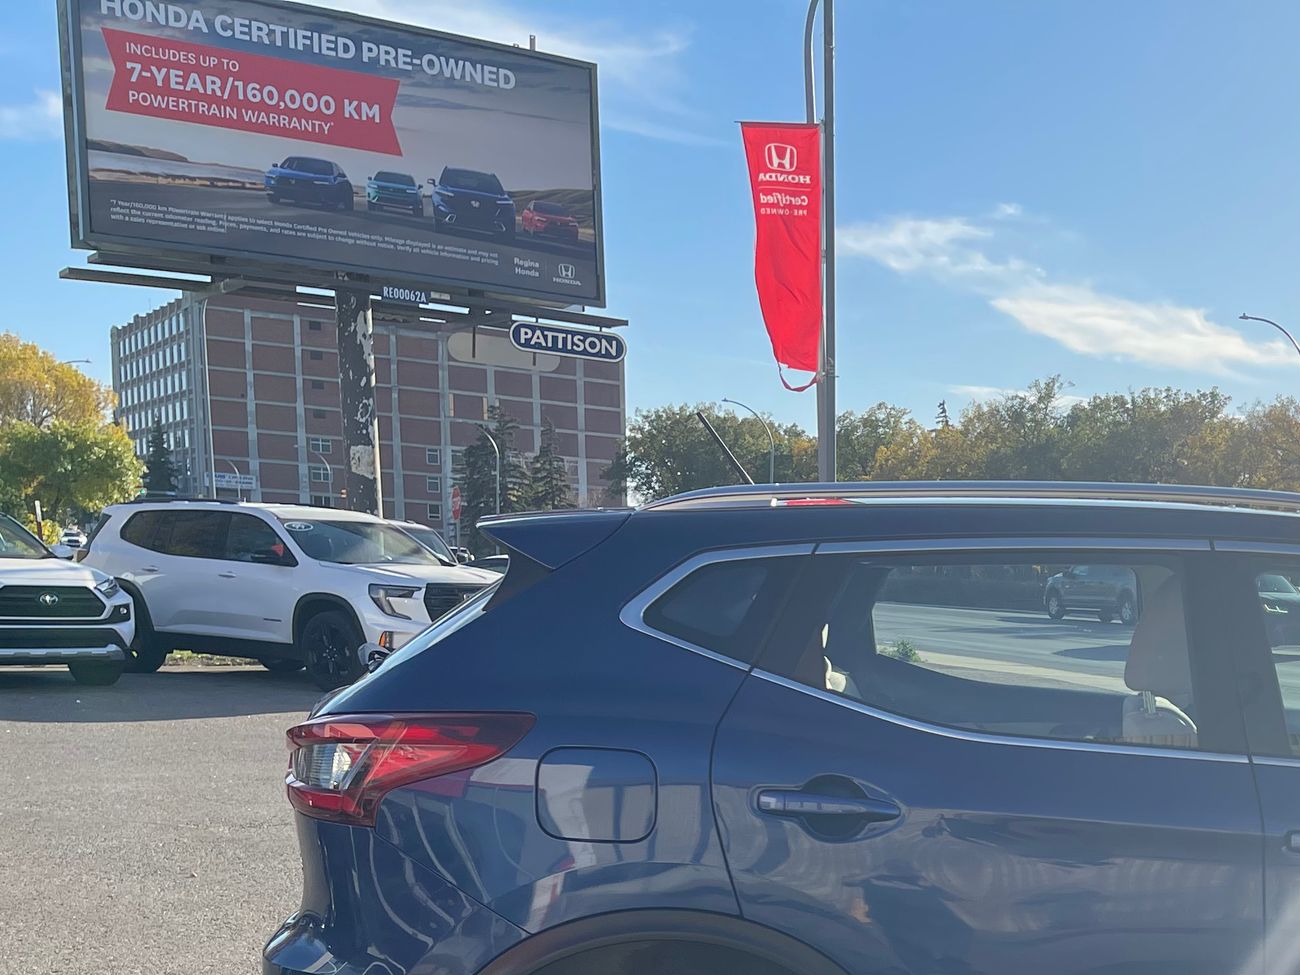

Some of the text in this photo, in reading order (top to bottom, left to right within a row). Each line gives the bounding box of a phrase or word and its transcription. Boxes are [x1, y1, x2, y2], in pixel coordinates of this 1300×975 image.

[101, 0, 516, 90] HONDA CERTIFIED PRE-OWNED
[125, 42, 240, 72] INCLUDES UP TO
[126, 62, 380, 123] 7-YEAR/160,000 KM
[128, 90, 238, 120] POWERTRAIN
[514, 257, 540, 268] Regina
[515, 268, 540, 278] Honda
[383, 286, 426, 303] RE00062A
[552, 277, 582, 286] HONDA
[520, 328, 617, 356] PATTISON
